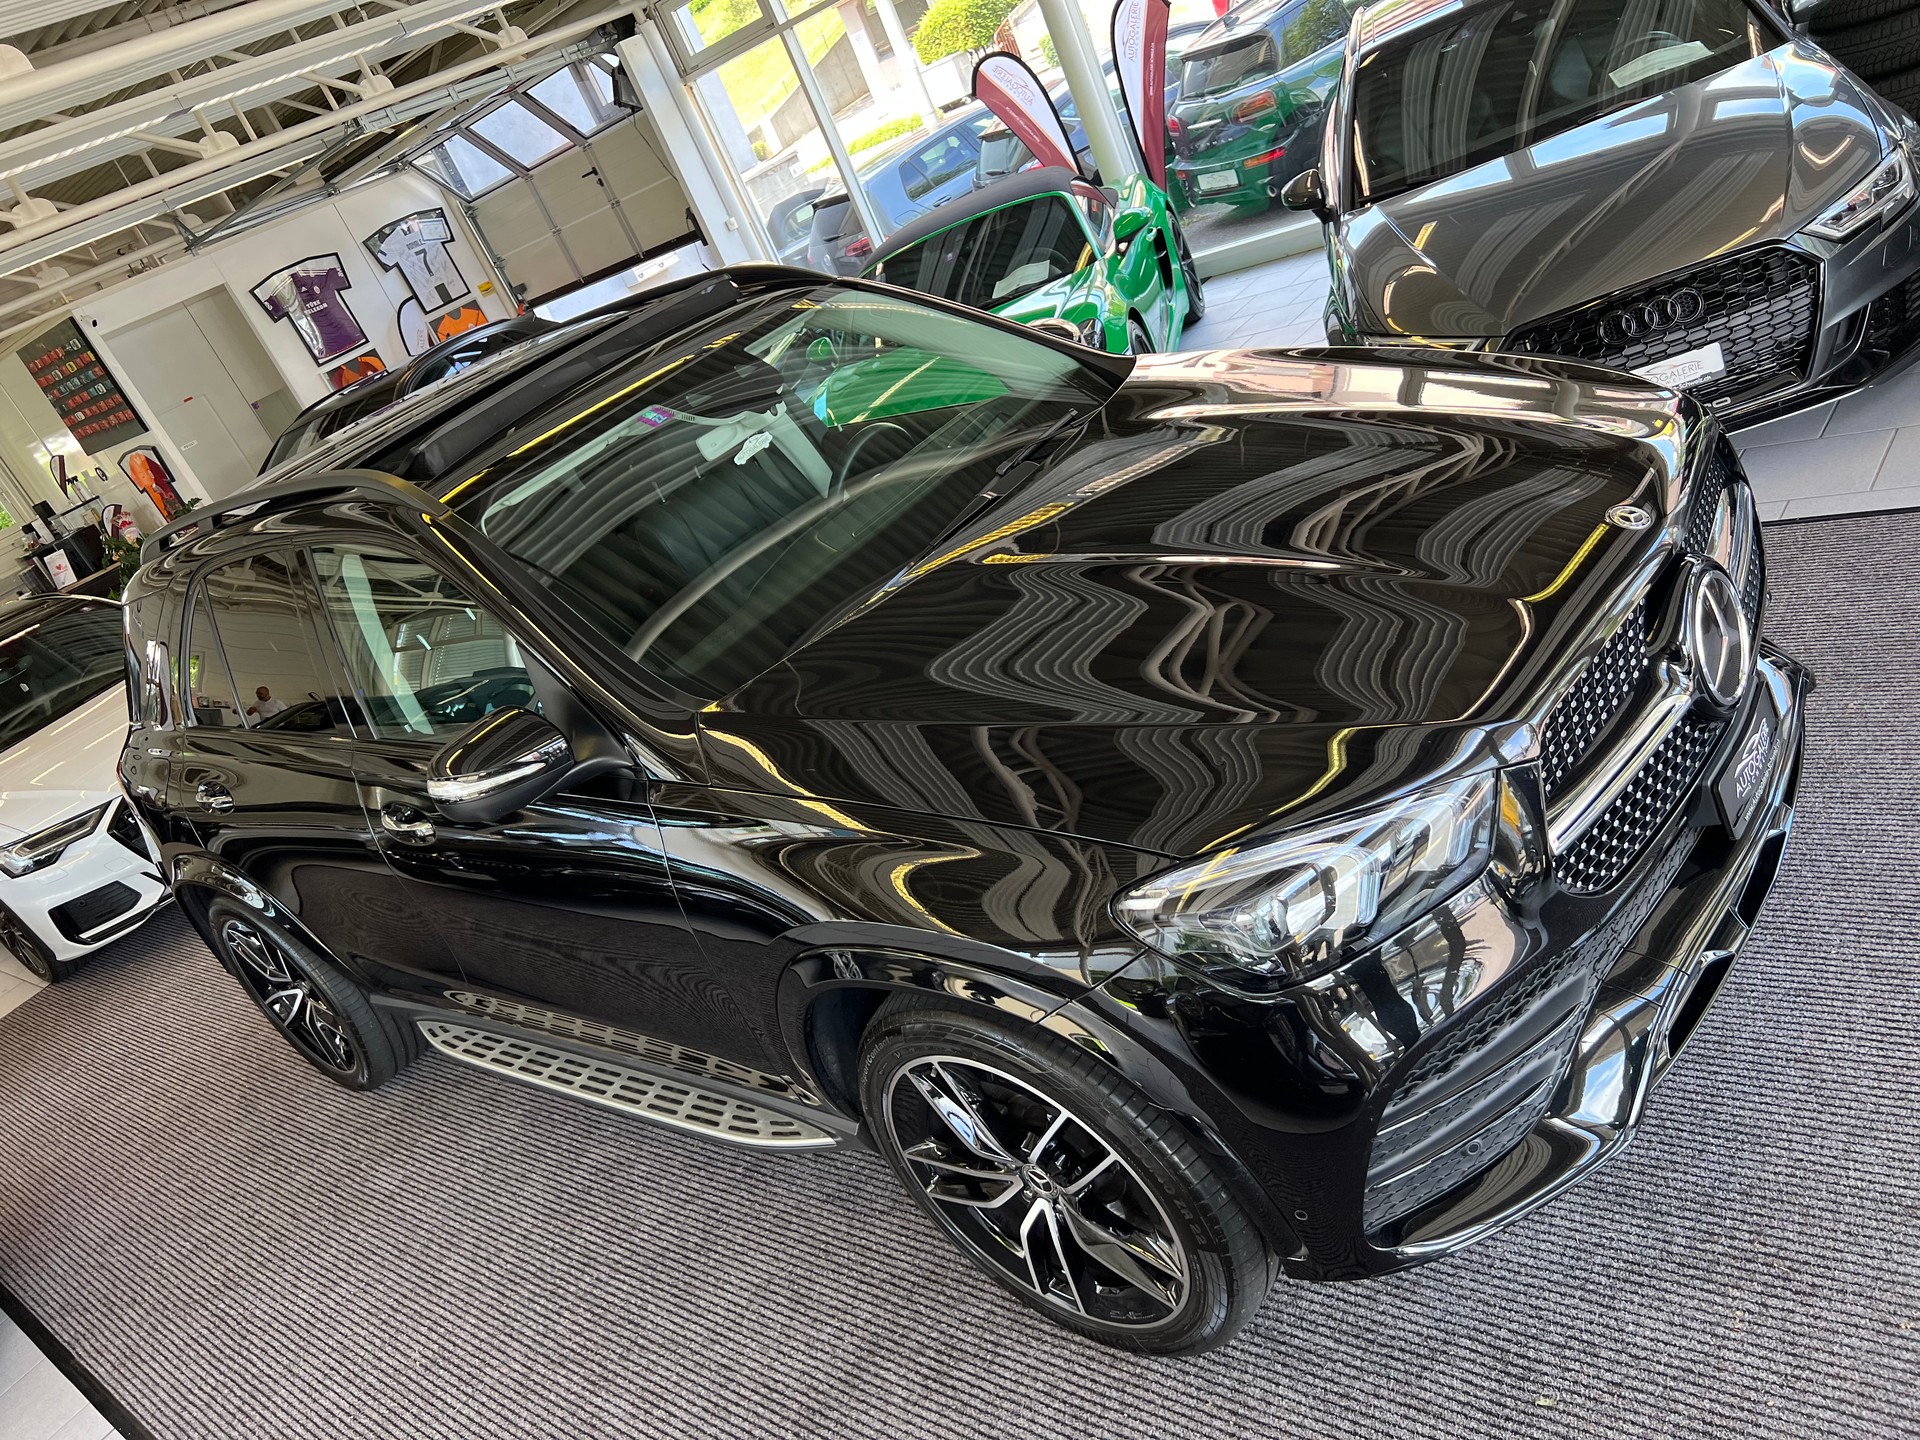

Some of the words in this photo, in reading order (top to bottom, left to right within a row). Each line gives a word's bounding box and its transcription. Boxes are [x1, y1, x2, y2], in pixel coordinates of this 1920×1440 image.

[1128, 1, 1139, 62] AUTOGALERIE
[414, 248, 434, 277] 7
[1651, 362, 1704, 384] OGALERIE
